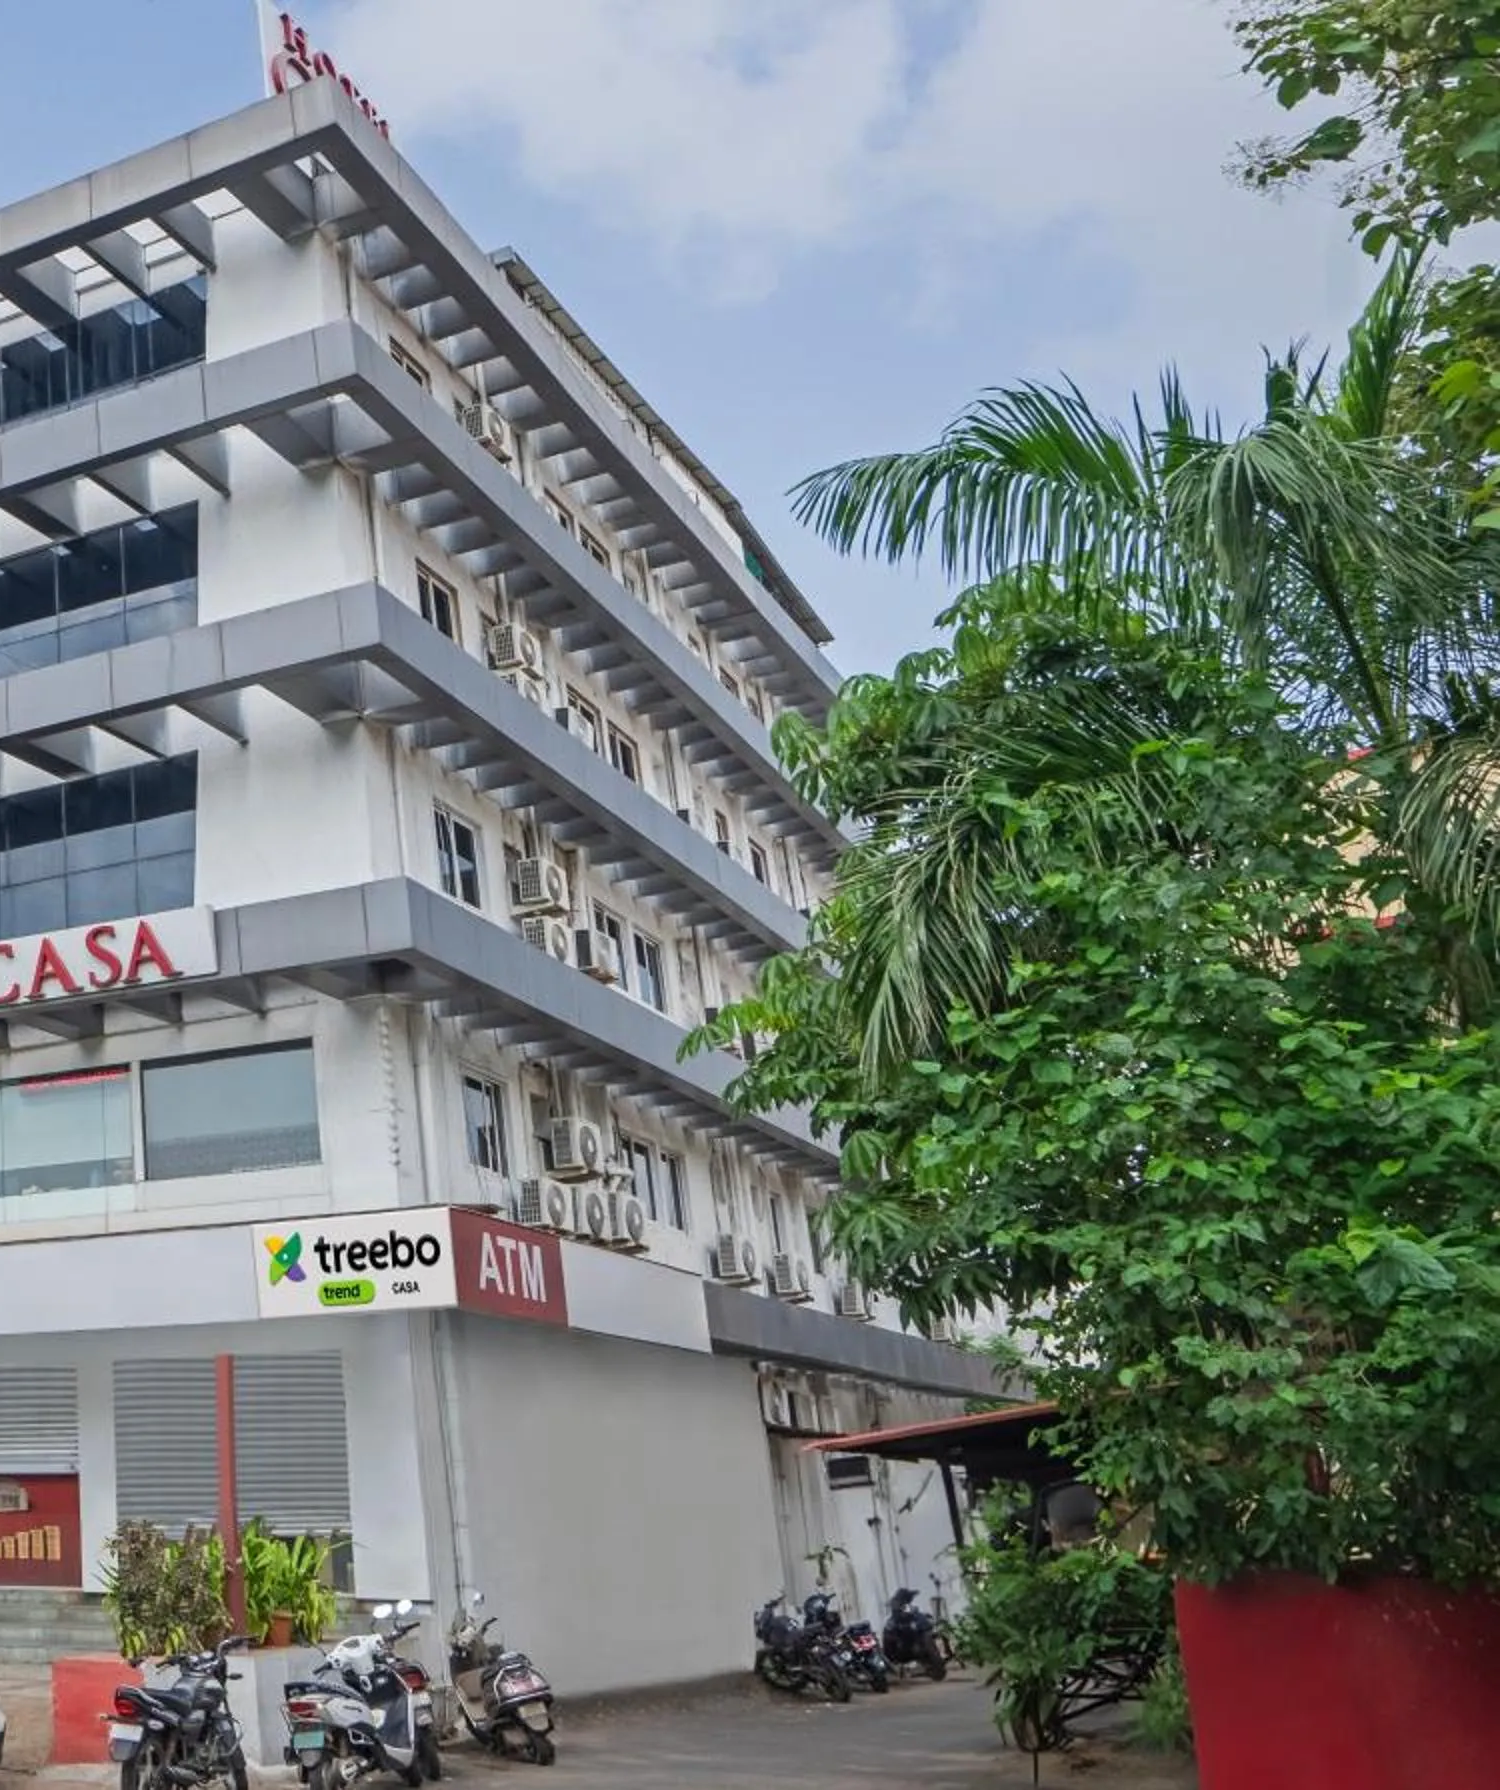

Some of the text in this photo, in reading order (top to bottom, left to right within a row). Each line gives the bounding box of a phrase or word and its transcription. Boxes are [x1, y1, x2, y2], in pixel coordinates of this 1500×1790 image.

[313, 1230, 441, 1274] treebo
[479, 1231, 547, 1303] ATM
[323, 1283, 361, 1300] trend
[391, 1280, 421, 1295] CASA
